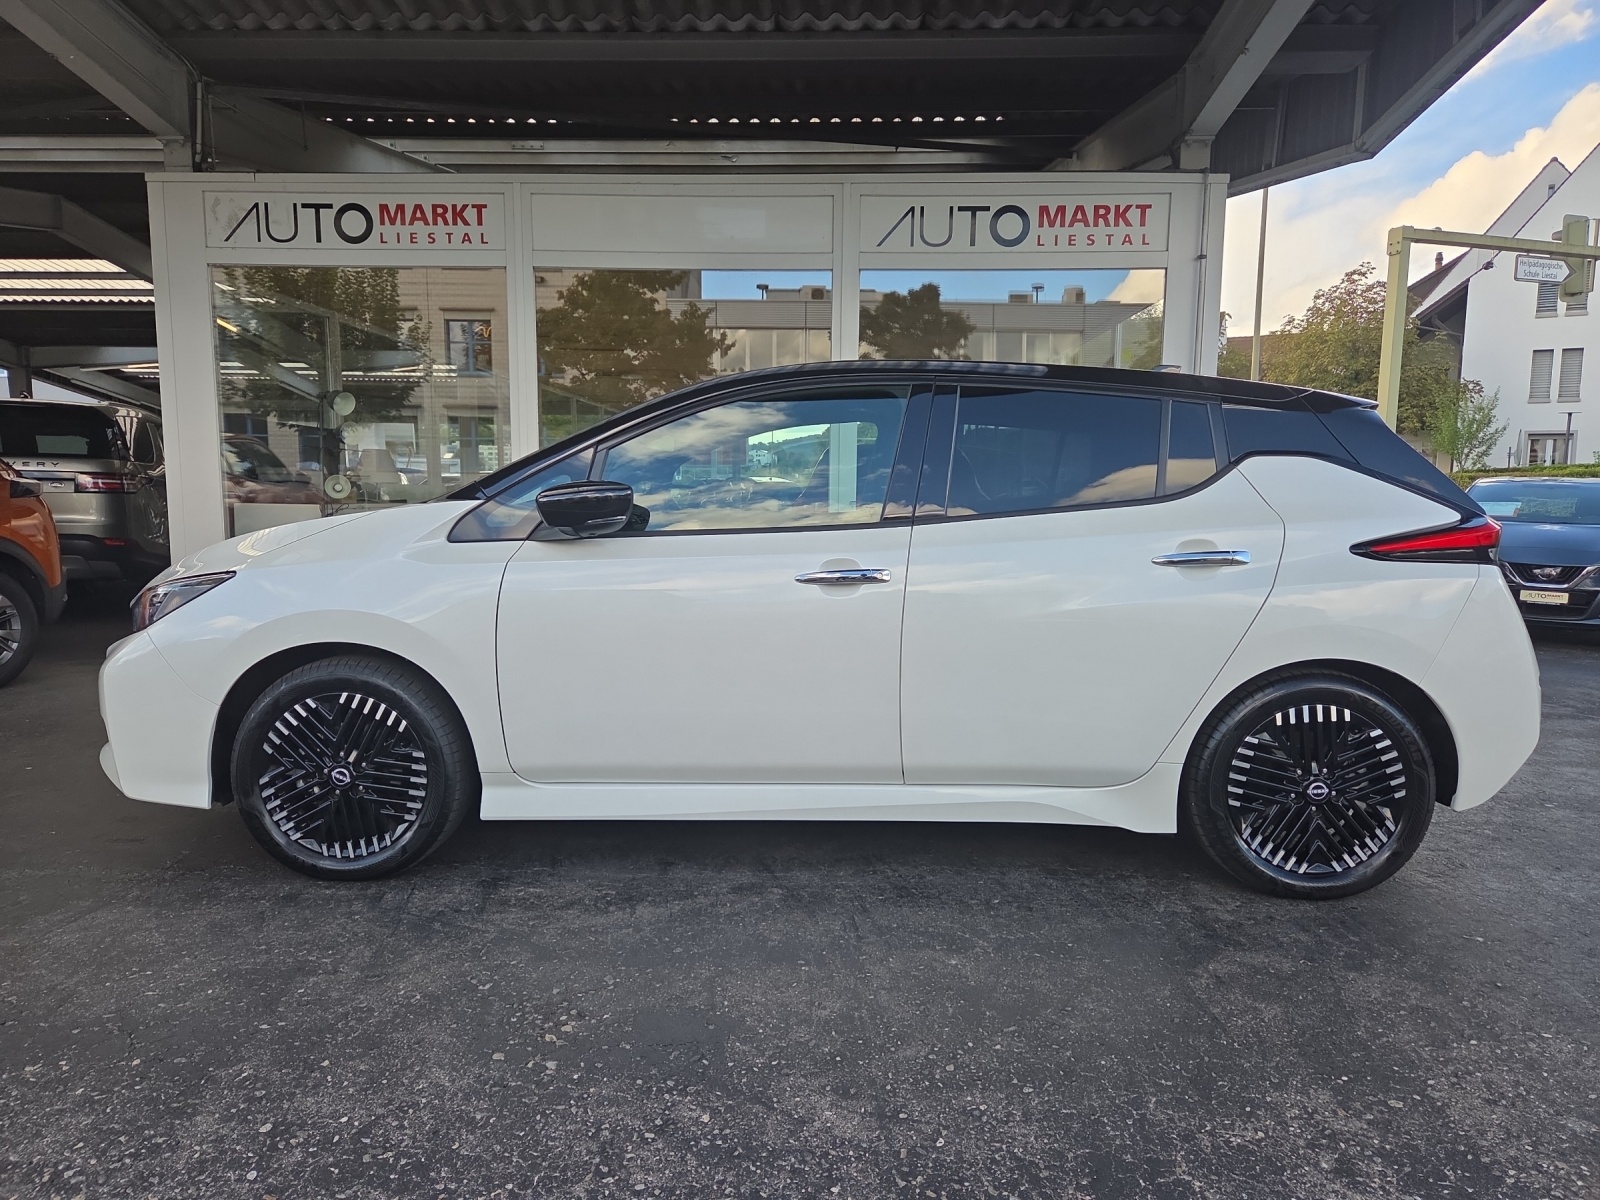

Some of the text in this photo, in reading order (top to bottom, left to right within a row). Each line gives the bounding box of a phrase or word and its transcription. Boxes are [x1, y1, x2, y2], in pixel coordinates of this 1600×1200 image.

[224, 202, 488, 244] AUTO MARKT
[876, 203, 1153, 247] AUTO MARKT
[379, 232, 489, 245] LIESTAL
[1036, 233, 1150, 247] LIESTAL
[1519, 259, 1563, 270] Heilpädagogische
[1523, 270, 1558, 280] Schule Liestal
